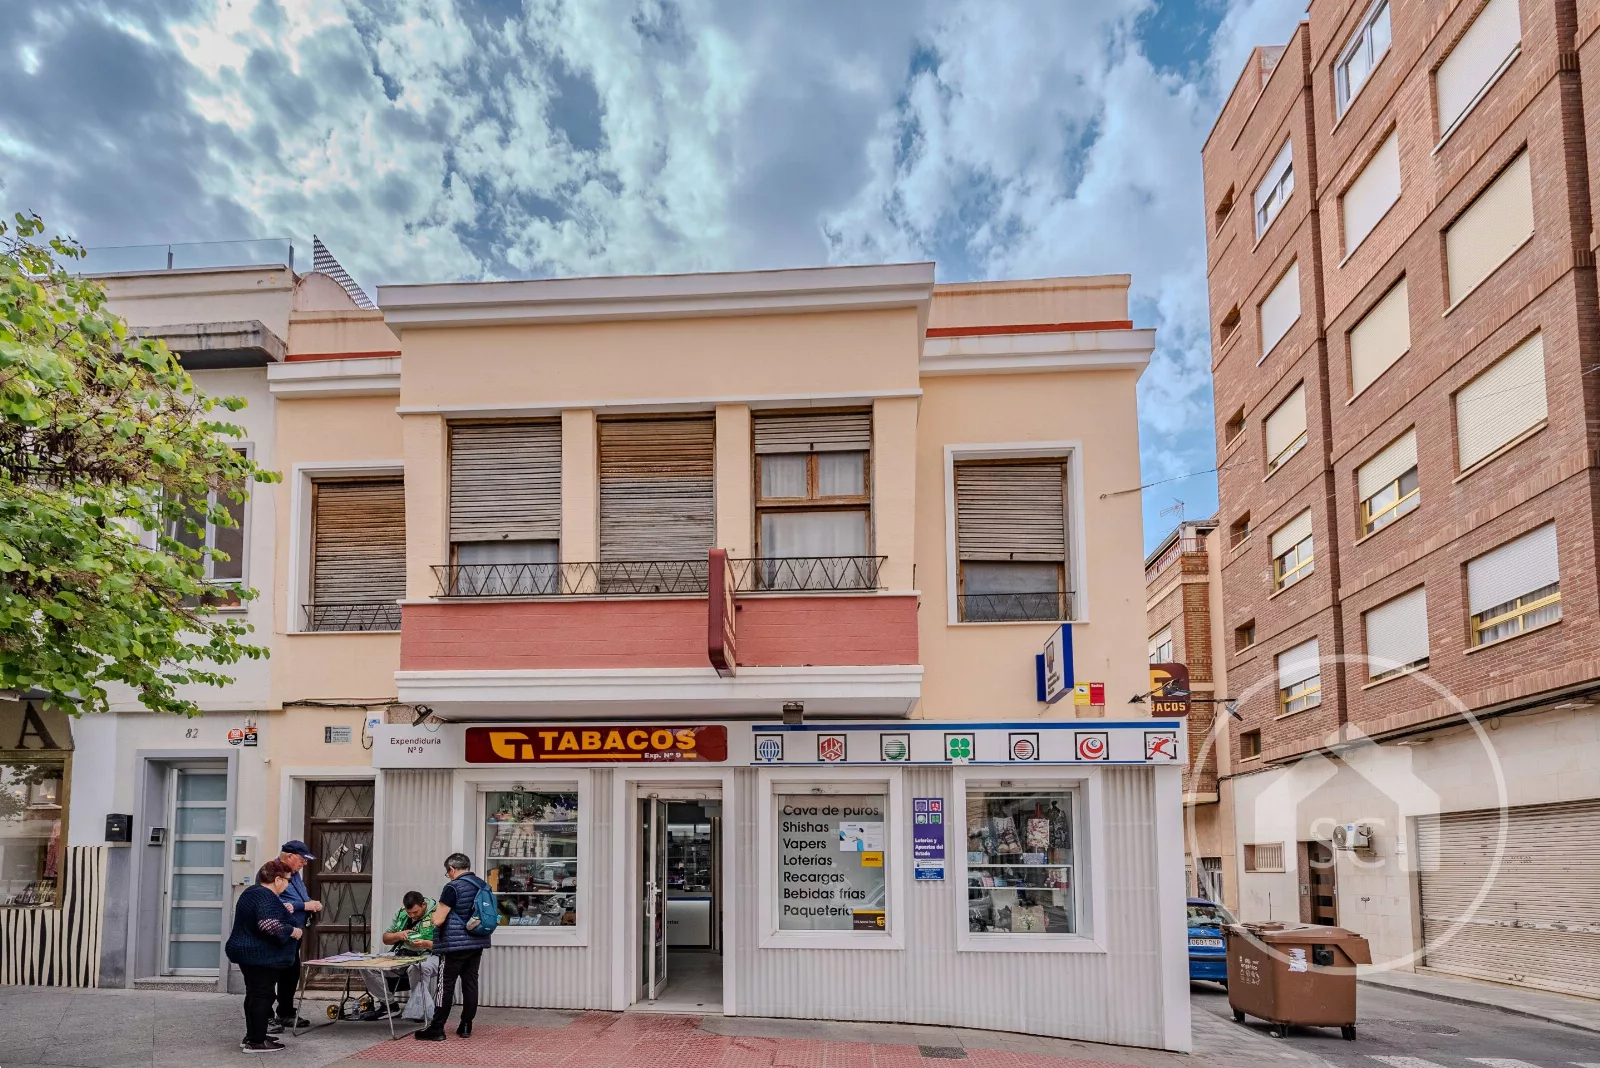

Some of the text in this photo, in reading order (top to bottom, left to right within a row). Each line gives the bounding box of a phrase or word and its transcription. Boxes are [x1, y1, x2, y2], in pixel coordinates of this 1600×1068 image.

[185, 728, 199, 739] 82
[539, 730, 696, 750] TABACOS
[418, 746, 424, 754] 9
[644, 752, 662, 760] Exp.
[783, 805, 879, 818] Cava de puros
[782, 821, 829, 833] Shishas
[783, 838, 827, 851] Vapers
[783, 854, 833, 866] Loterías
[783, 871, 845, 884] Recargas
[783, 888, 866, 899] Bebidas frías
